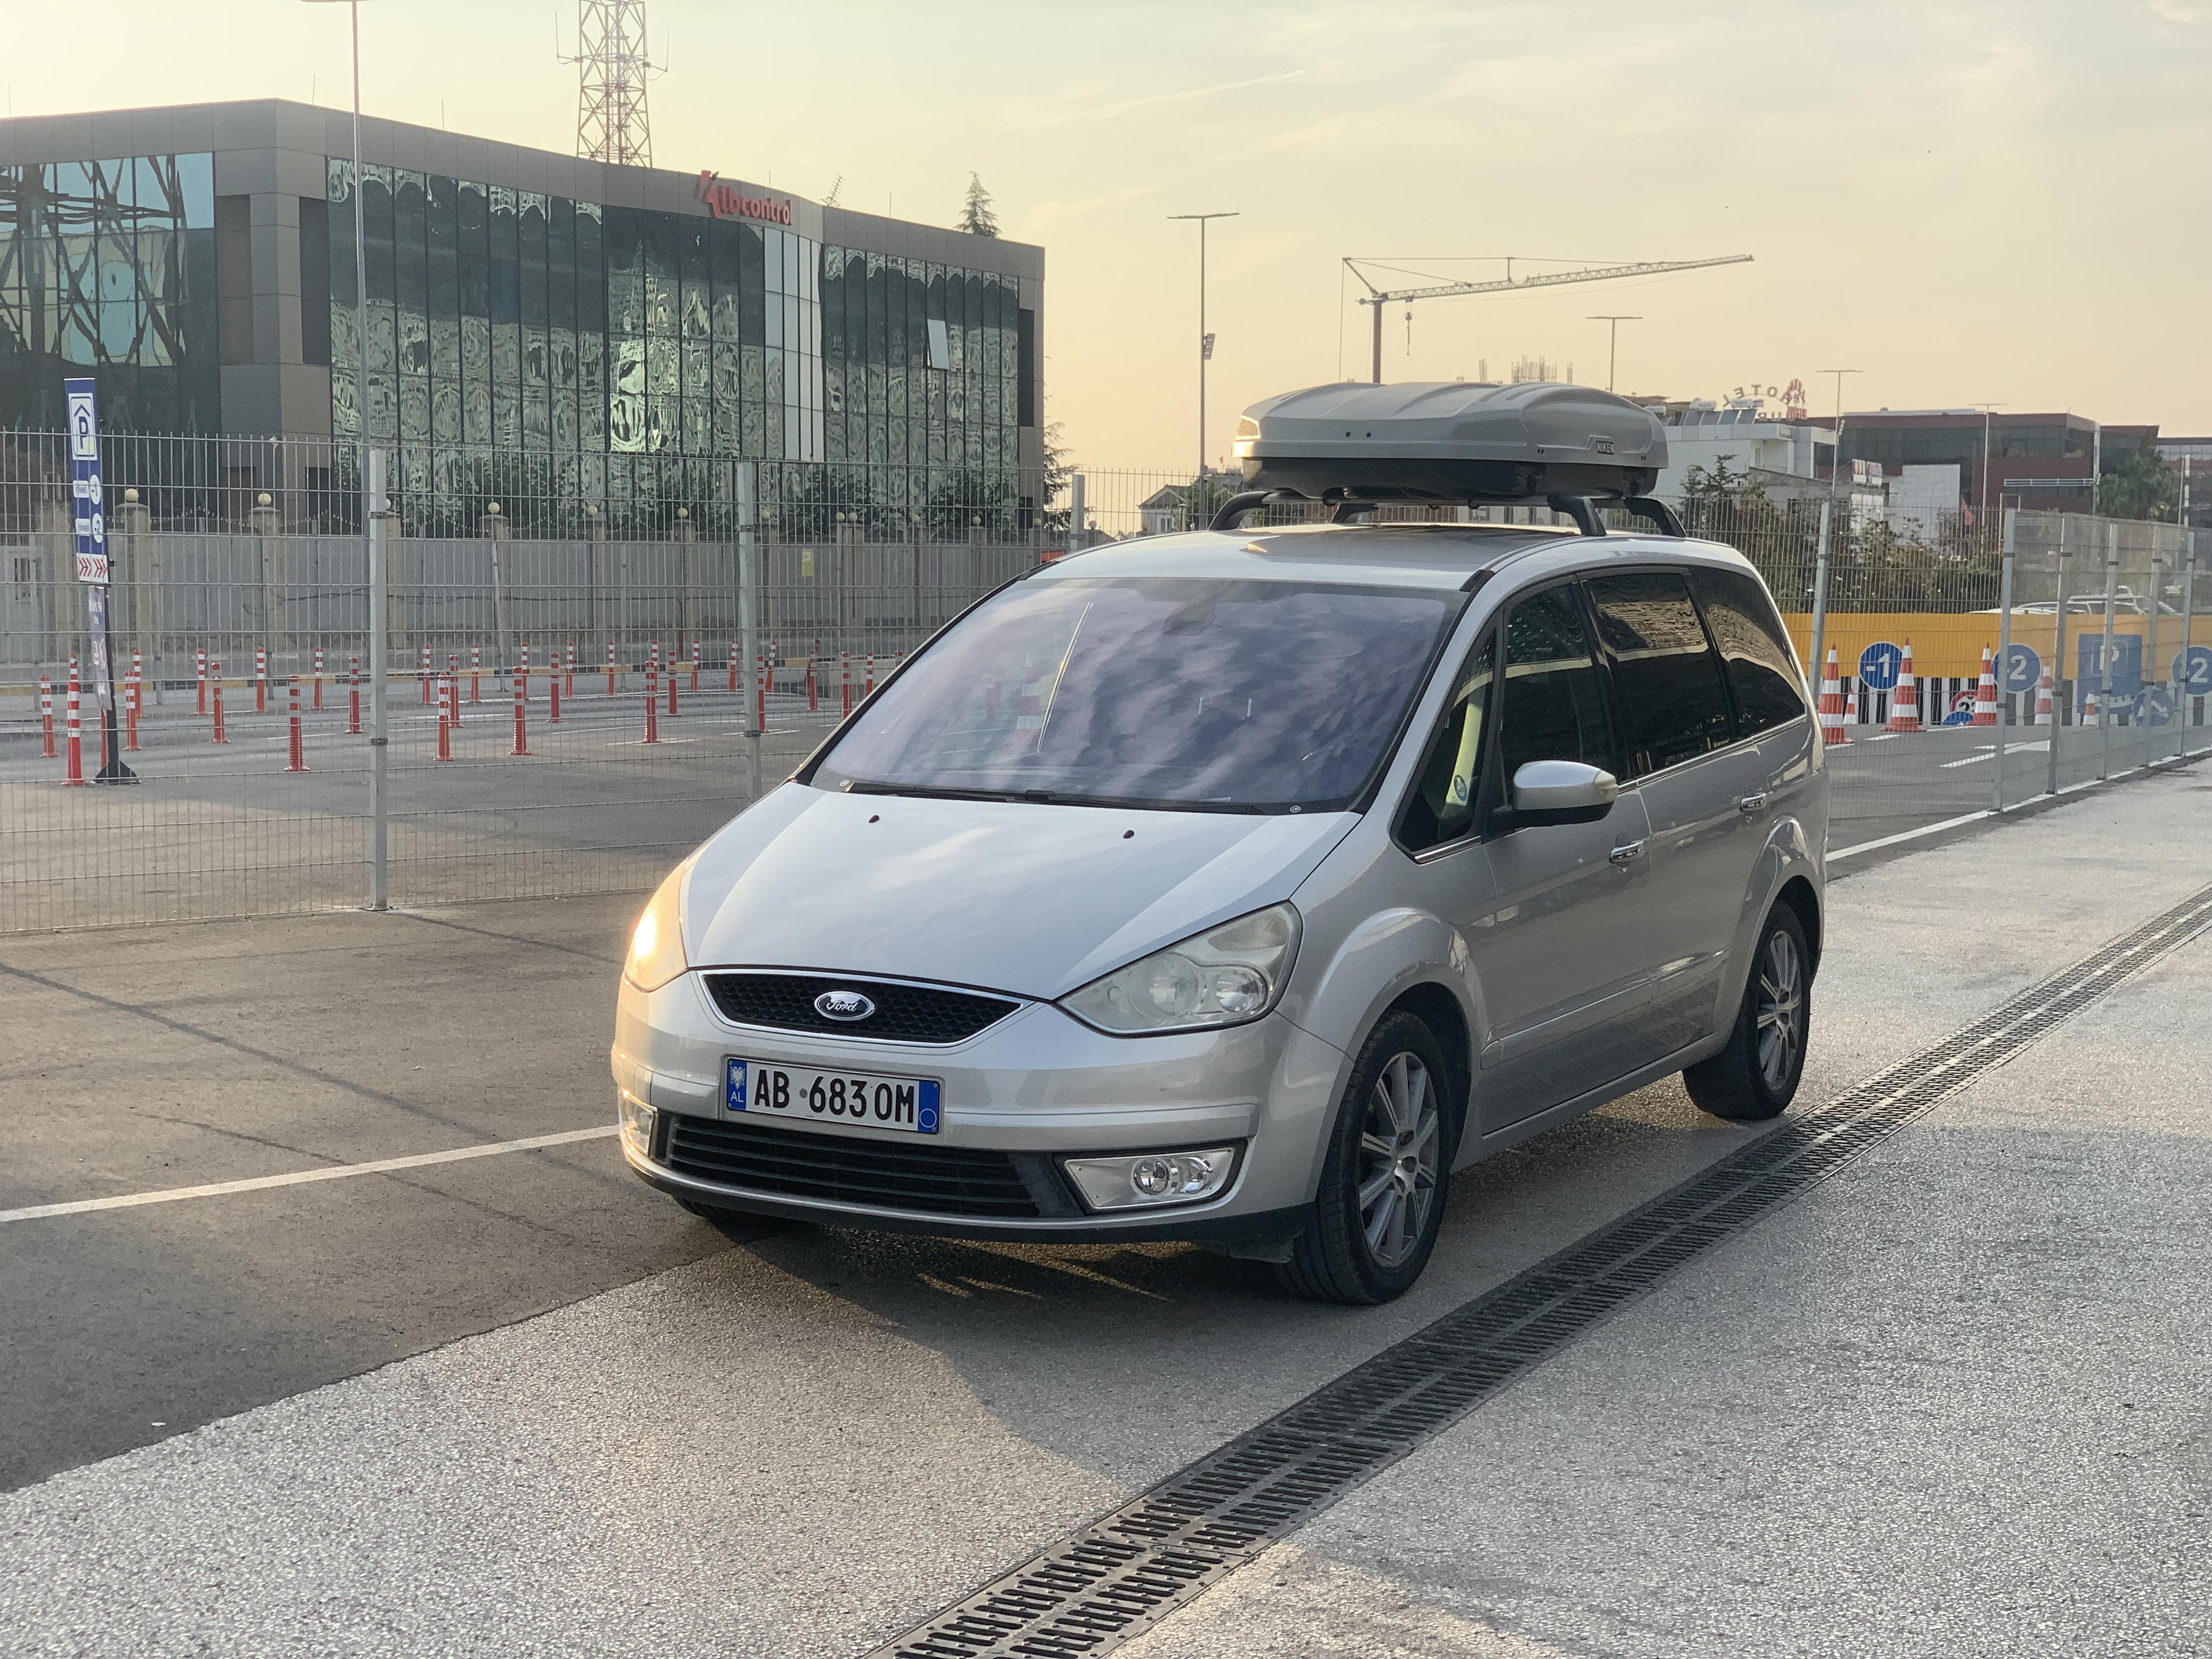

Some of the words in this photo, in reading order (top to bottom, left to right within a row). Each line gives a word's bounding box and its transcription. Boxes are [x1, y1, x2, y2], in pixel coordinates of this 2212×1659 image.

[78, 416, 89, 449] P
[1866, 653, 1889, 677] -1
[826, 1001, 858, 1012] Ford
[730, 1091, 744, 1103] AL
[754, 1069, 790, 1108] AB
